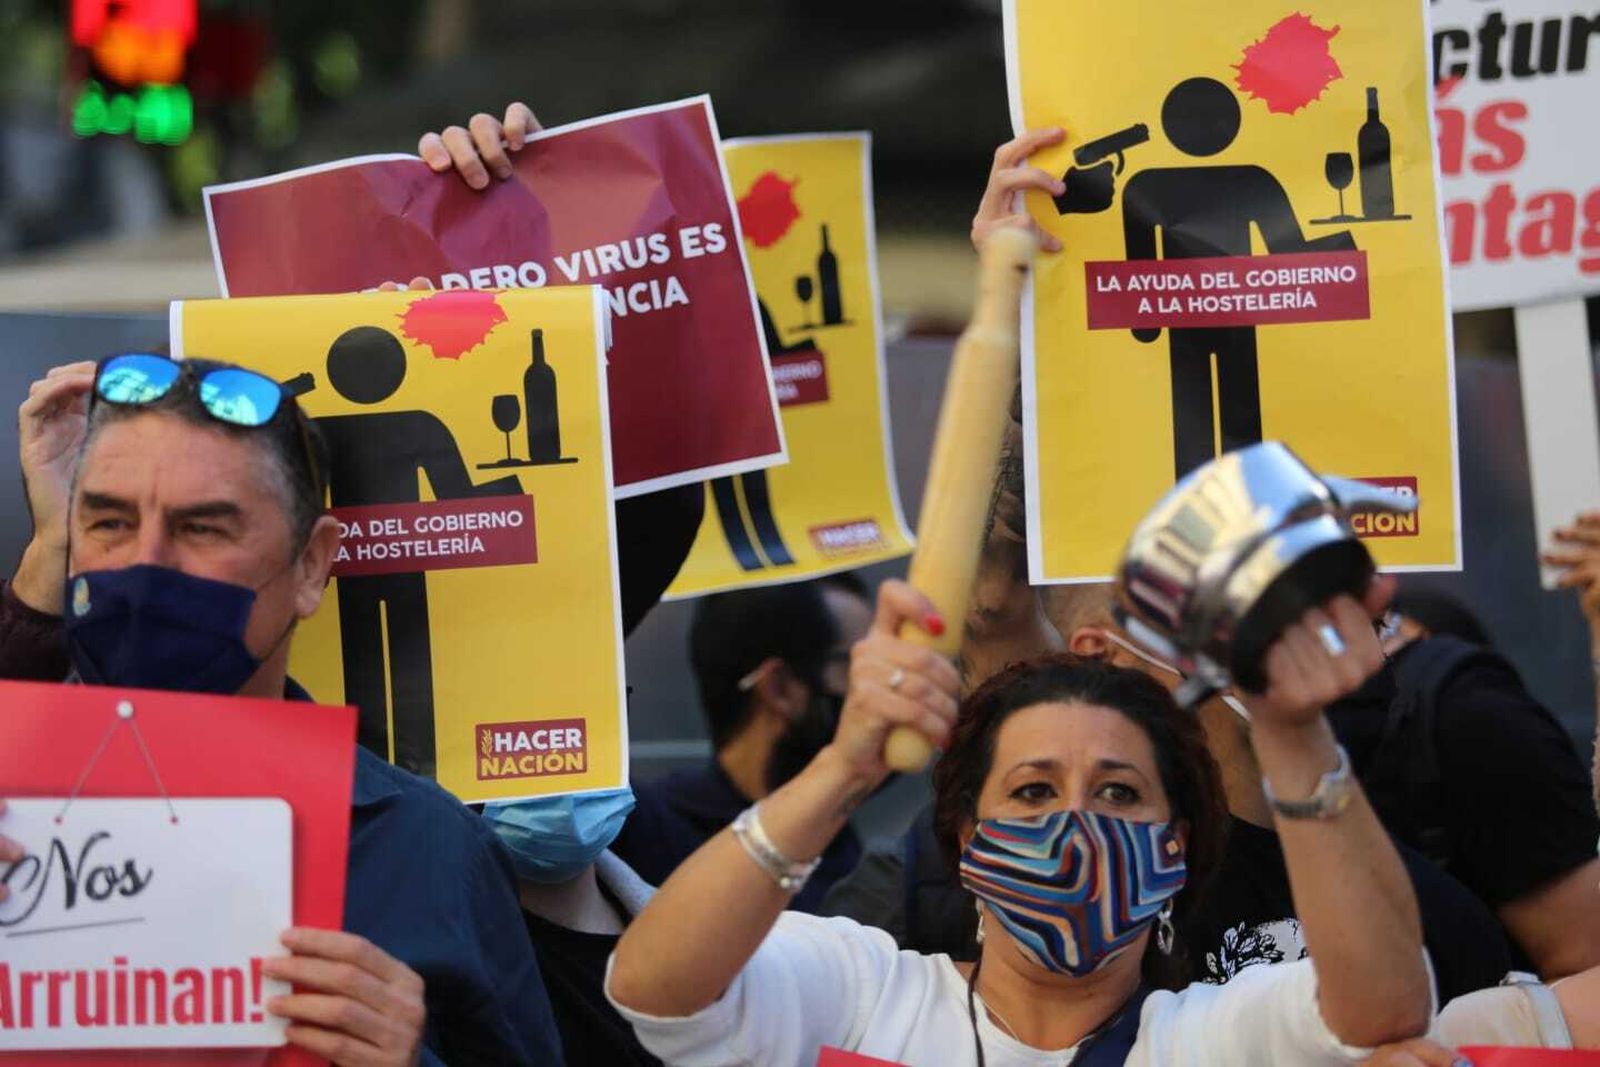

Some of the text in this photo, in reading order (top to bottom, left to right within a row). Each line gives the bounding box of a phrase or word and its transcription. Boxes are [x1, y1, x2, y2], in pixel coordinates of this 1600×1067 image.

[554, 232, 670, 282] VIRUS
[679, 222, 727, 259] ES
[1096, 265, 1357, 292] LA AYUDA DEL GOBIERNO
[1138, 286, 1317, 314] A LA HOSTELERÍA
[369, 518, 409, 537] DEL
[414, 510, 523, 534] GOBIERNO
[357, 532, 485, 561] HOSTELERÍA
[494, 727, 583, 753] HACER
[480, 748, 584, 776] NACIÓN
[0, 831, 154, 928] Nos
